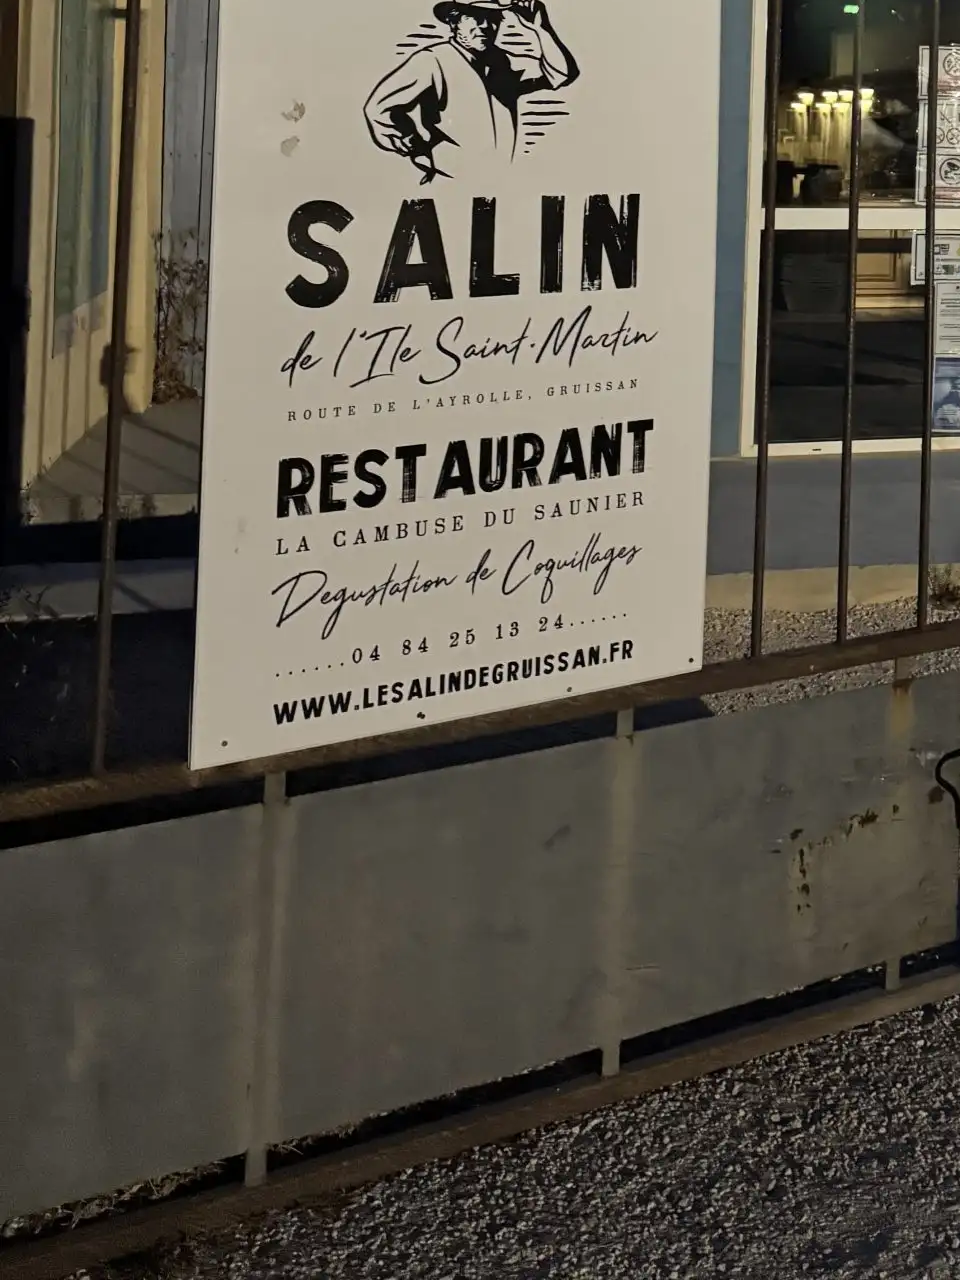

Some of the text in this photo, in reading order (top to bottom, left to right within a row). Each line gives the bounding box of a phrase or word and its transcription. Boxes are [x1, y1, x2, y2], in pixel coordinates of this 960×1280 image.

[285, 193, 641, 308] SALIN
[280, 330, 323, 388] de
[287, 378, 638, 422] ROUTE DE L'AYROLLE, GRUISSAN
[276, 418, 655, 519] RESTAURANT
[275, 491, 645, 556] LA CAMBUSE DU SAUNIER
[271, 531, 643, 640] Degustation de Coquillages
[401, 636, 429, 656] 84
[449, 628, 476, 648] 25
[495, 621, 520, 640] 13
[272, 639, 635, 726] WWW.LESALINDEGRUISSAN.FR
